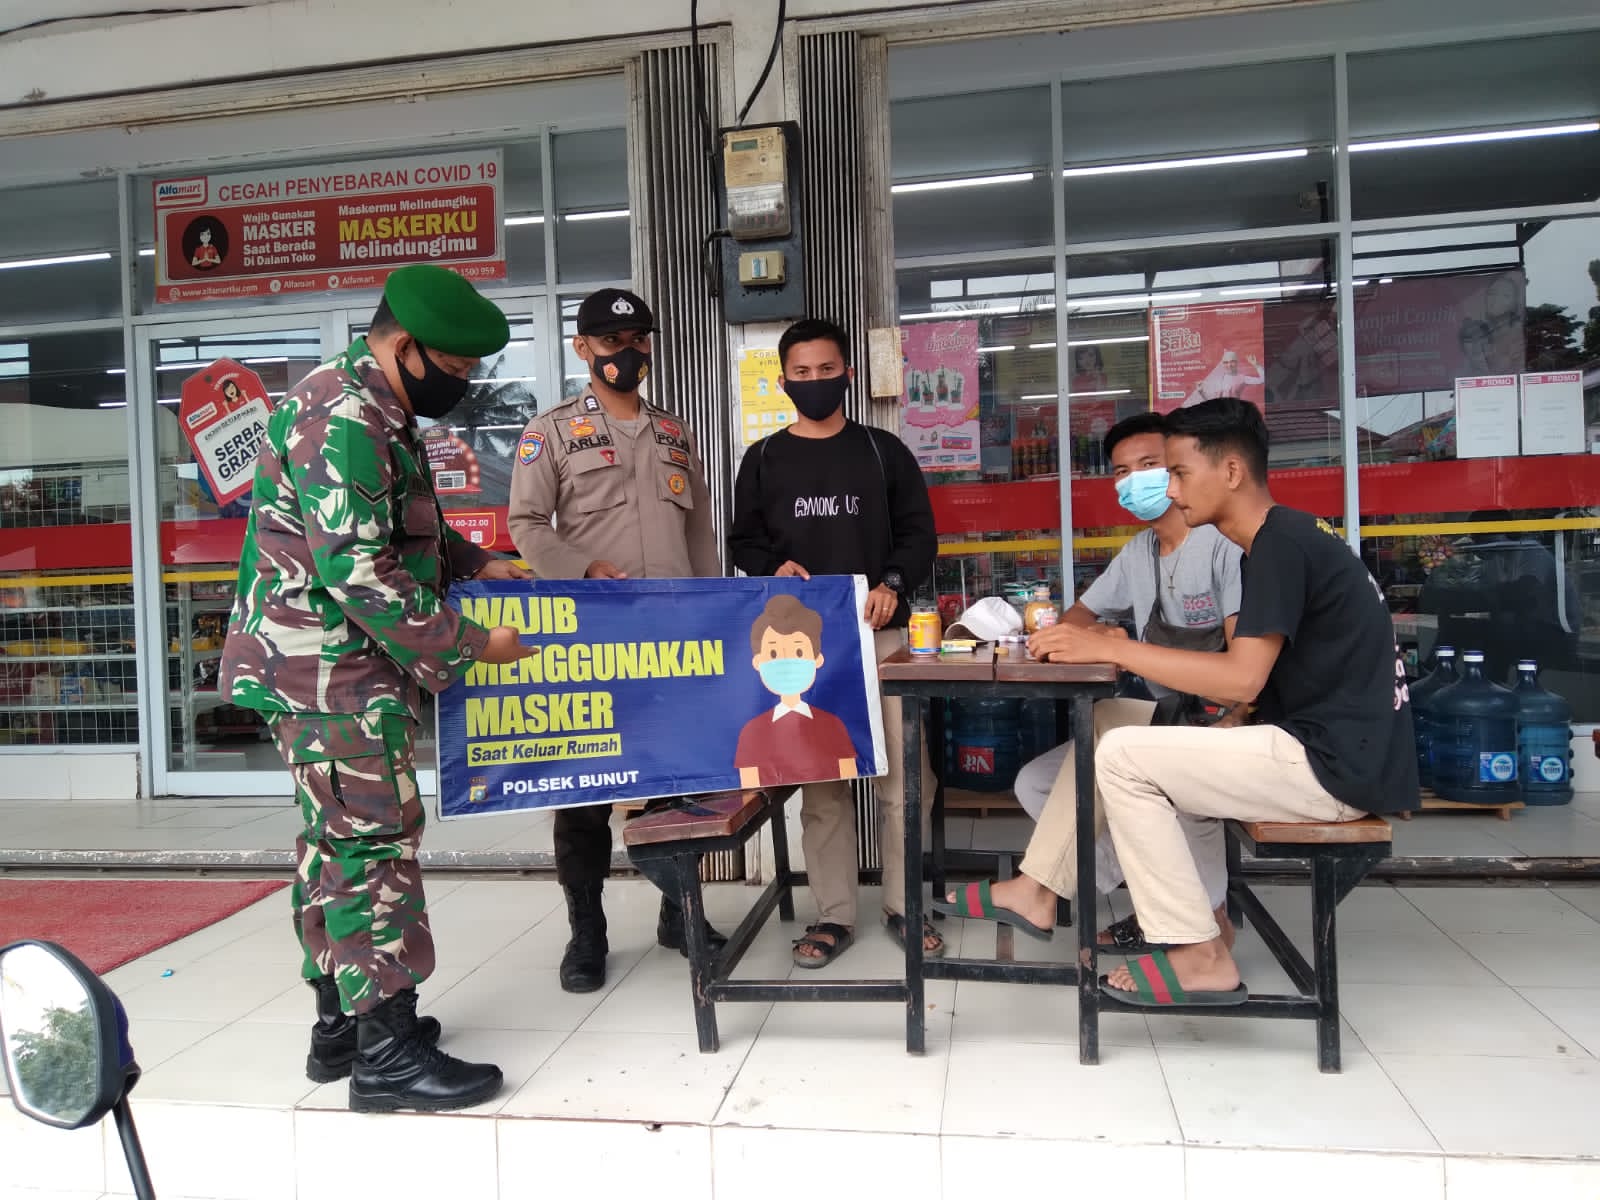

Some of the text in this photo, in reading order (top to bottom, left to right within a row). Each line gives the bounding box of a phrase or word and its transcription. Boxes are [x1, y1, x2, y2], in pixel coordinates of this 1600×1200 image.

[159, 183, 201, 196] Alfamart
[218, 162, 497, 201] CEGAH PENYEBARAN COVID 19
[243, 210, 316, 224] Wajib Gunakan
[338, 195, 477, 217] Maskermu Melindungiku
[243, 221, 316, 241] MASKER
[338, 210, 477, 242] MASKERKU
[243, 239, 316, 256] Saat Berada
[243, 252, 316, 267] Di Dalam Toko
[339, 235, 477, 260] Melindungimu
[283, 280, 315, 289] Alfamart
[342, 275, 375, 286] Alfamart
[214, 420, 265, 462] SERBA
[569, 435, 611, 451] ARLIS
[217, 434, 264, 479] GRATI
[794, 494, 860, 518] AMONG US
[460, 596, 578, 635] WAJIB
[465, 691, 614, 738] MASKER
[471, 738, 618, 762] Saat Keluar Rumah
[502, 770, 639, 795] POLSEK BUNUT
